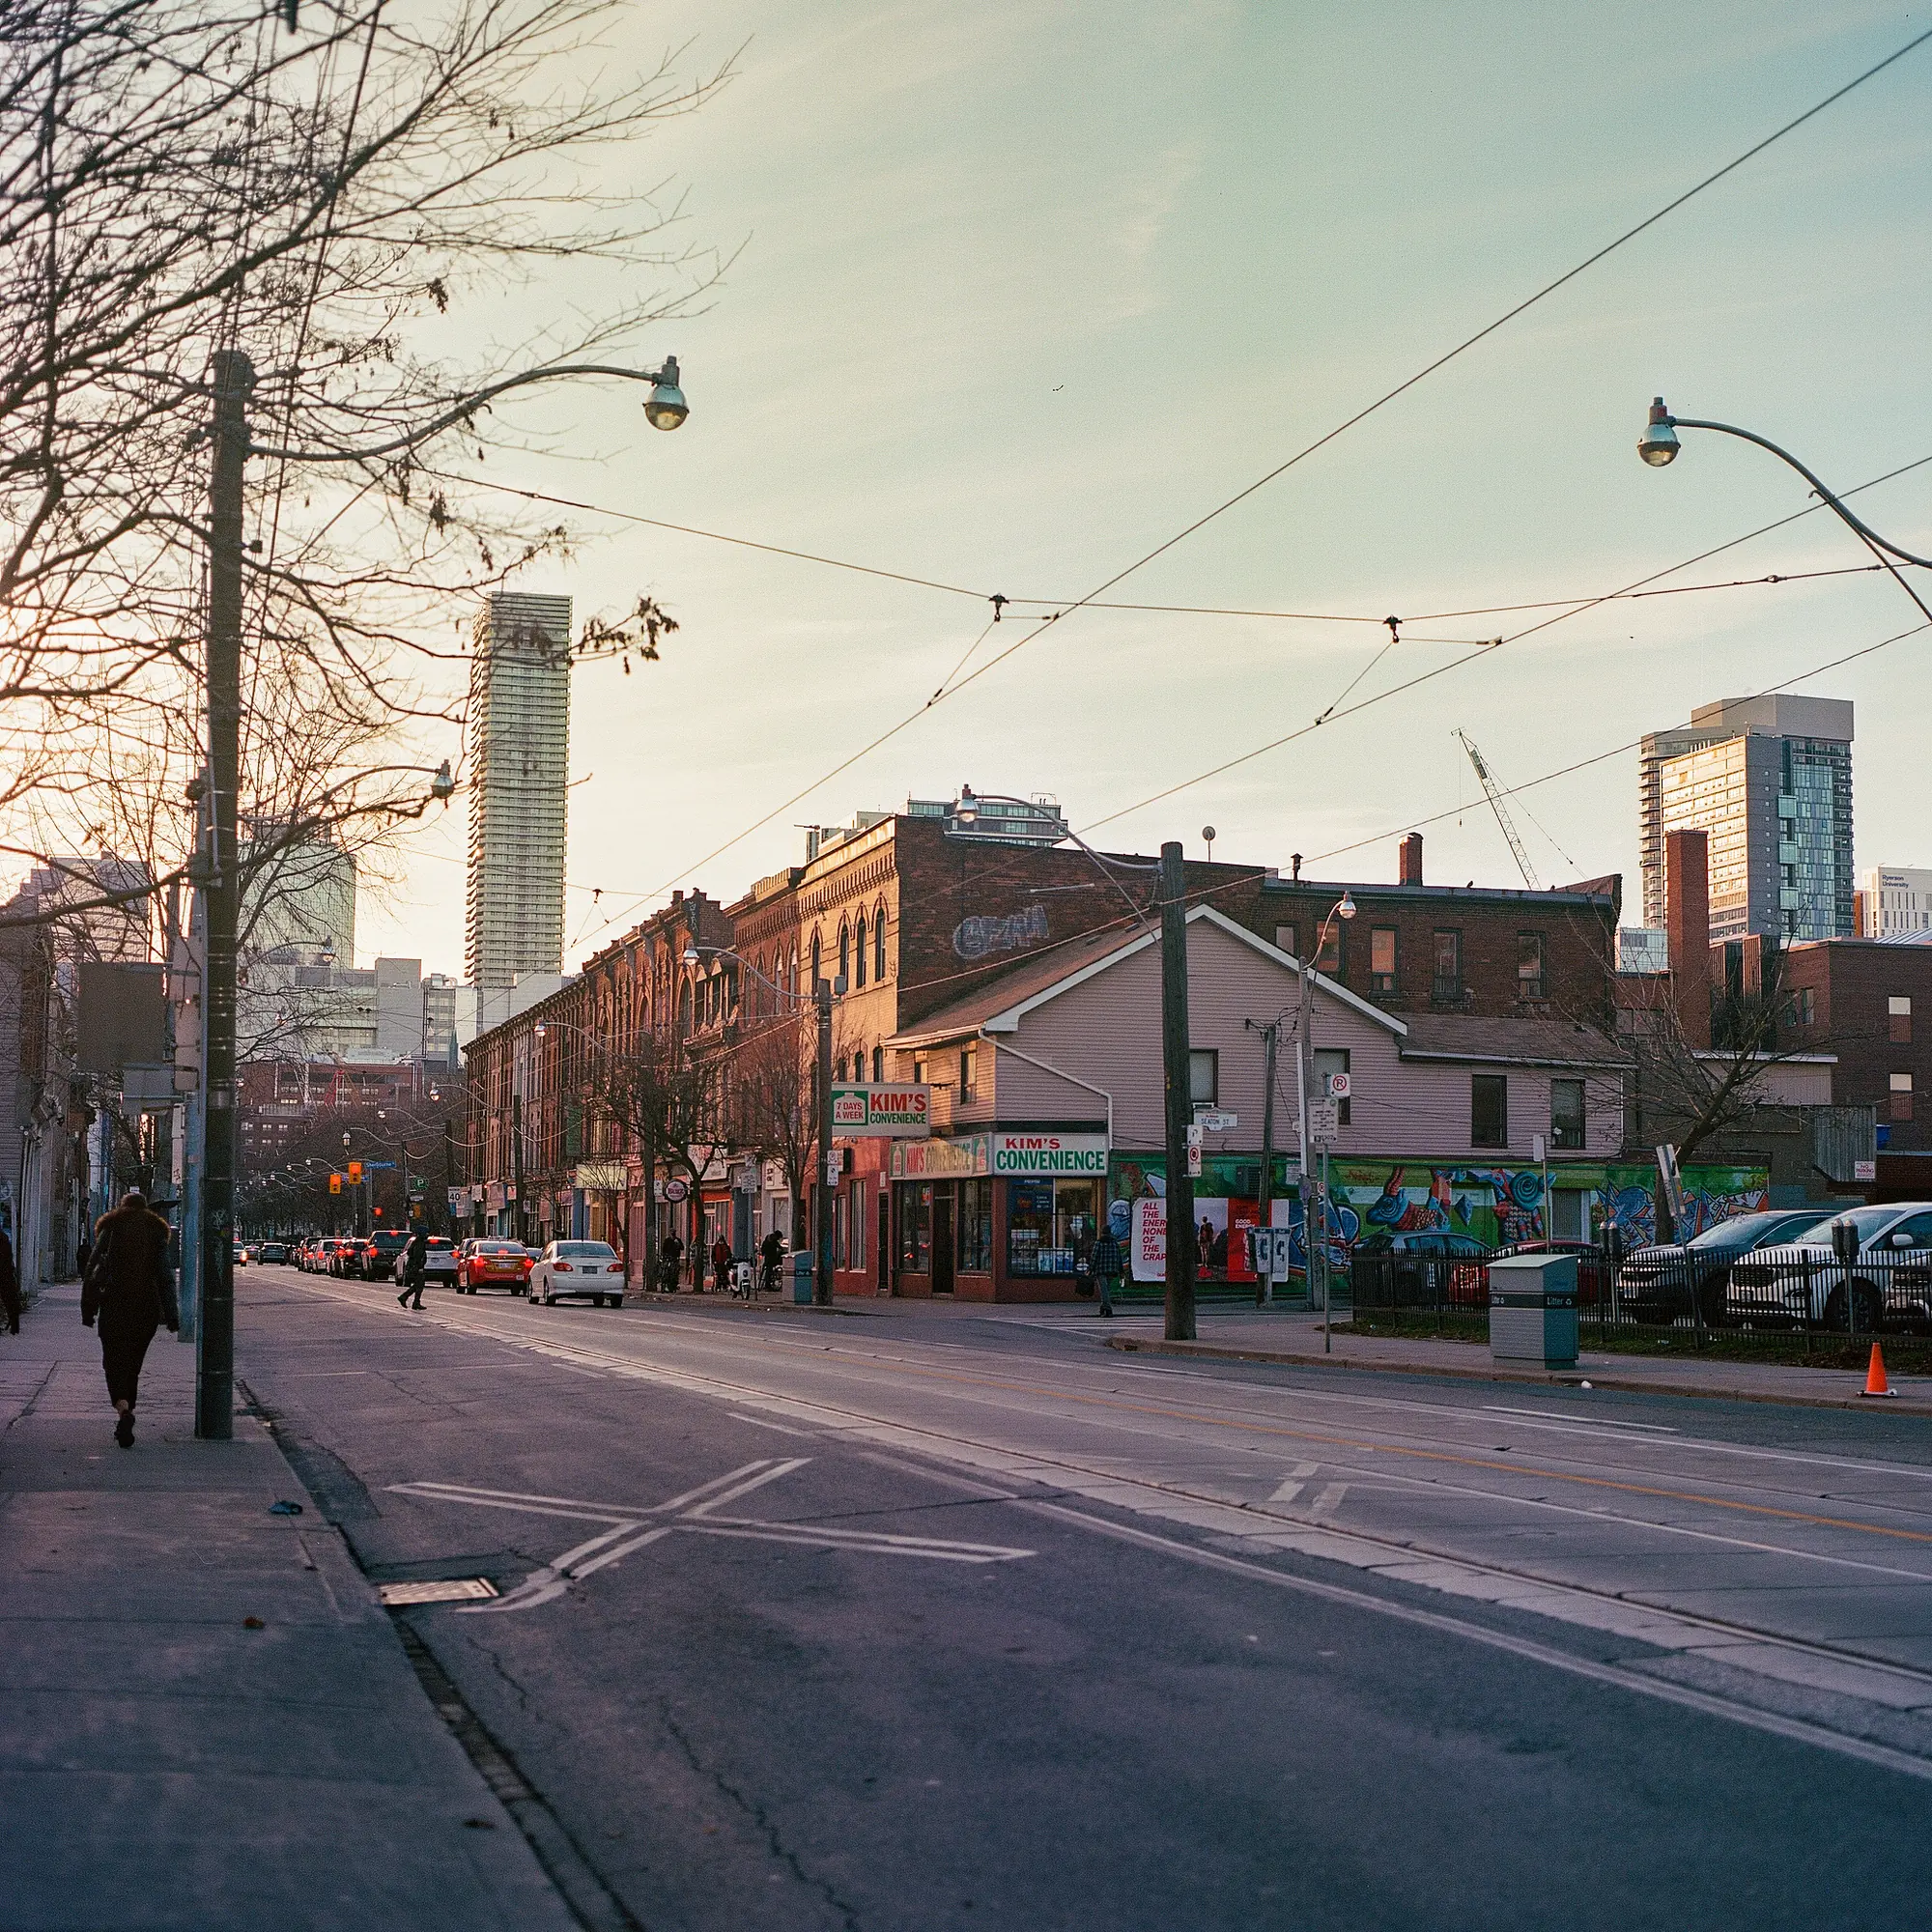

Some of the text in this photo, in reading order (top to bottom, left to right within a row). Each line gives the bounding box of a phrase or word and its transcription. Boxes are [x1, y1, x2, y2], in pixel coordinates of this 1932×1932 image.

[870, 1093, 926, 1112] KIM'S
[869, 1113, 926, 1123] CONVENIENCE
[1006, 1138, 1061, 1150] KIM'S
[996, 1150, 1105, 1170] CONVENIENCE
[449, 1192, 460, 1201] 40
[1547, 1296, 1564, 1305] Litter
